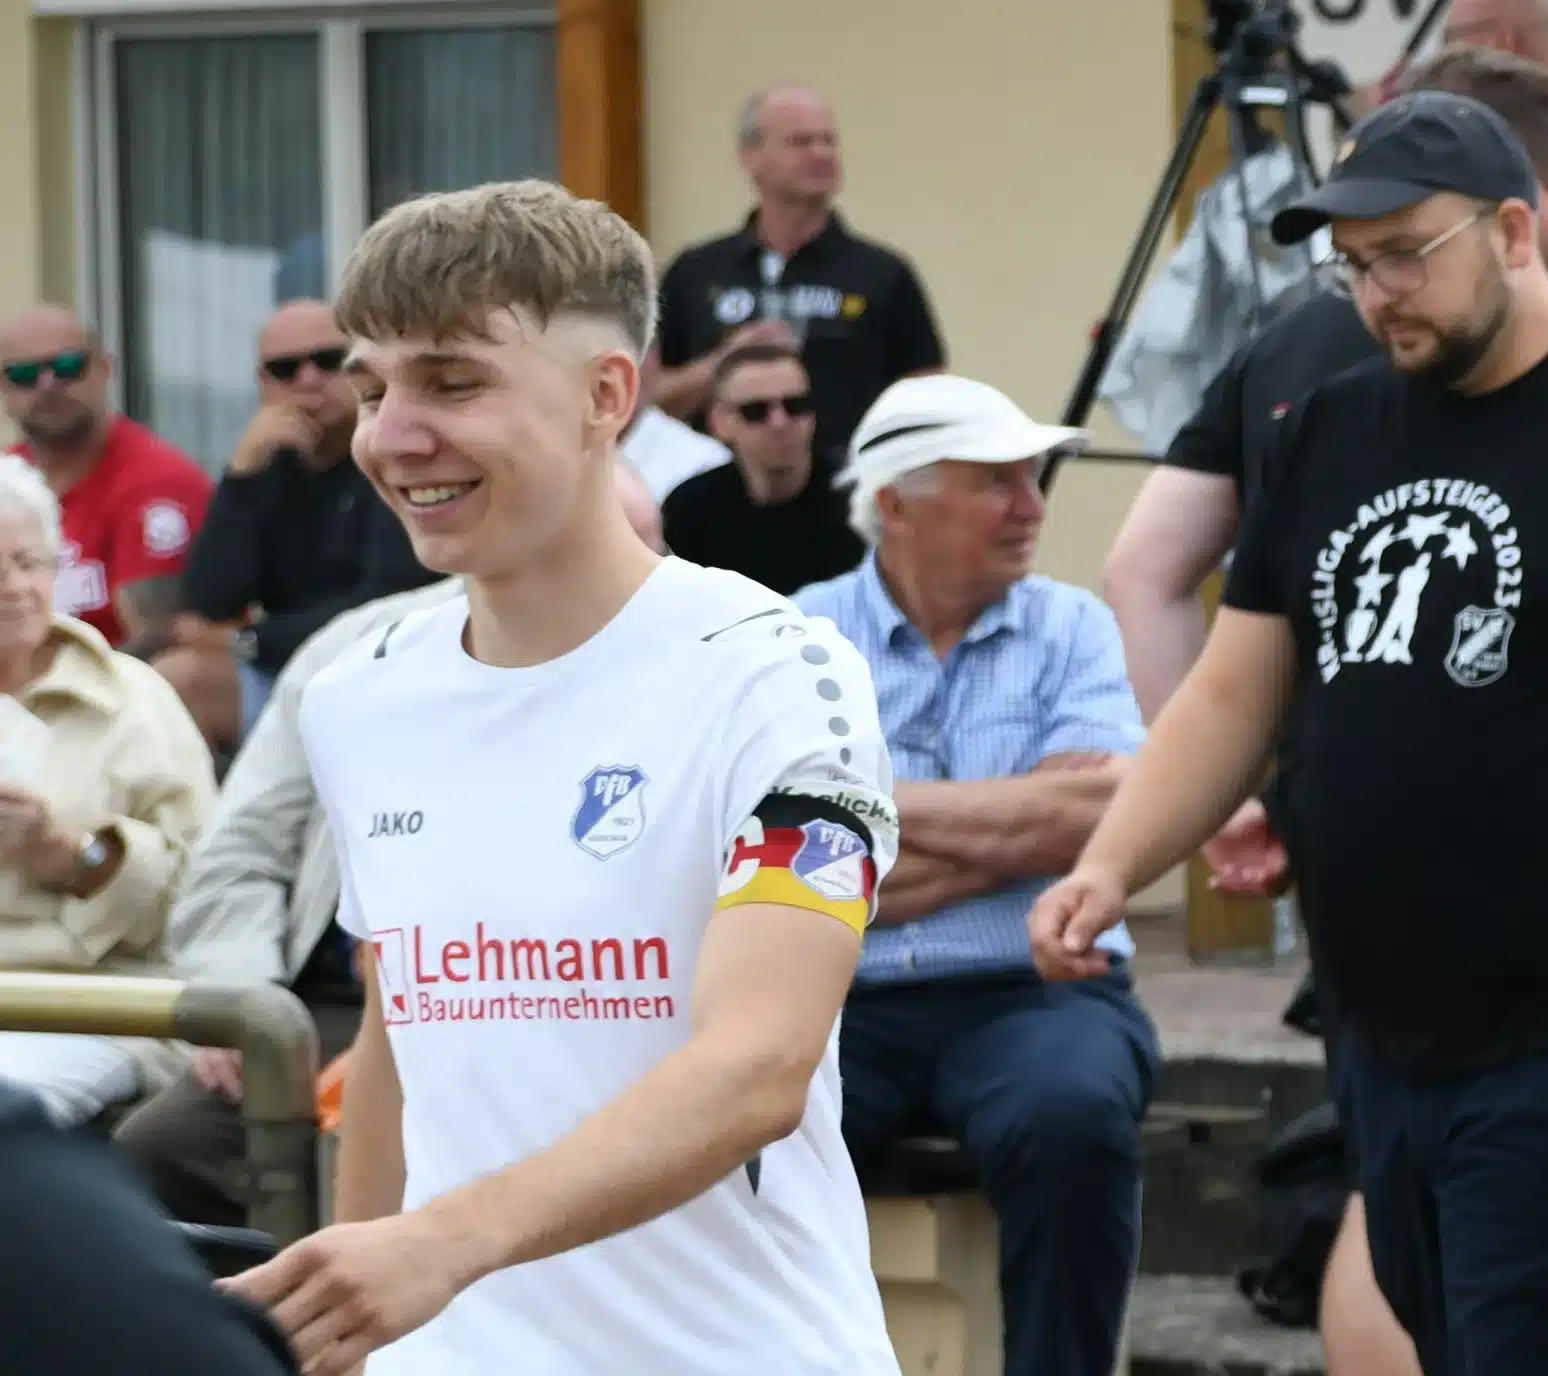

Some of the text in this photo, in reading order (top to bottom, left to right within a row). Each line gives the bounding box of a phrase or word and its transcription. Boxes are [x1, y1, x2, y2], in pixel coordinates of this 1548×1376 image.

[368, 810, 424, 838] JAKO
[414, 921, 671, 984] Lehmann
[417, 987, 676, 1022] Bauunternehmen
